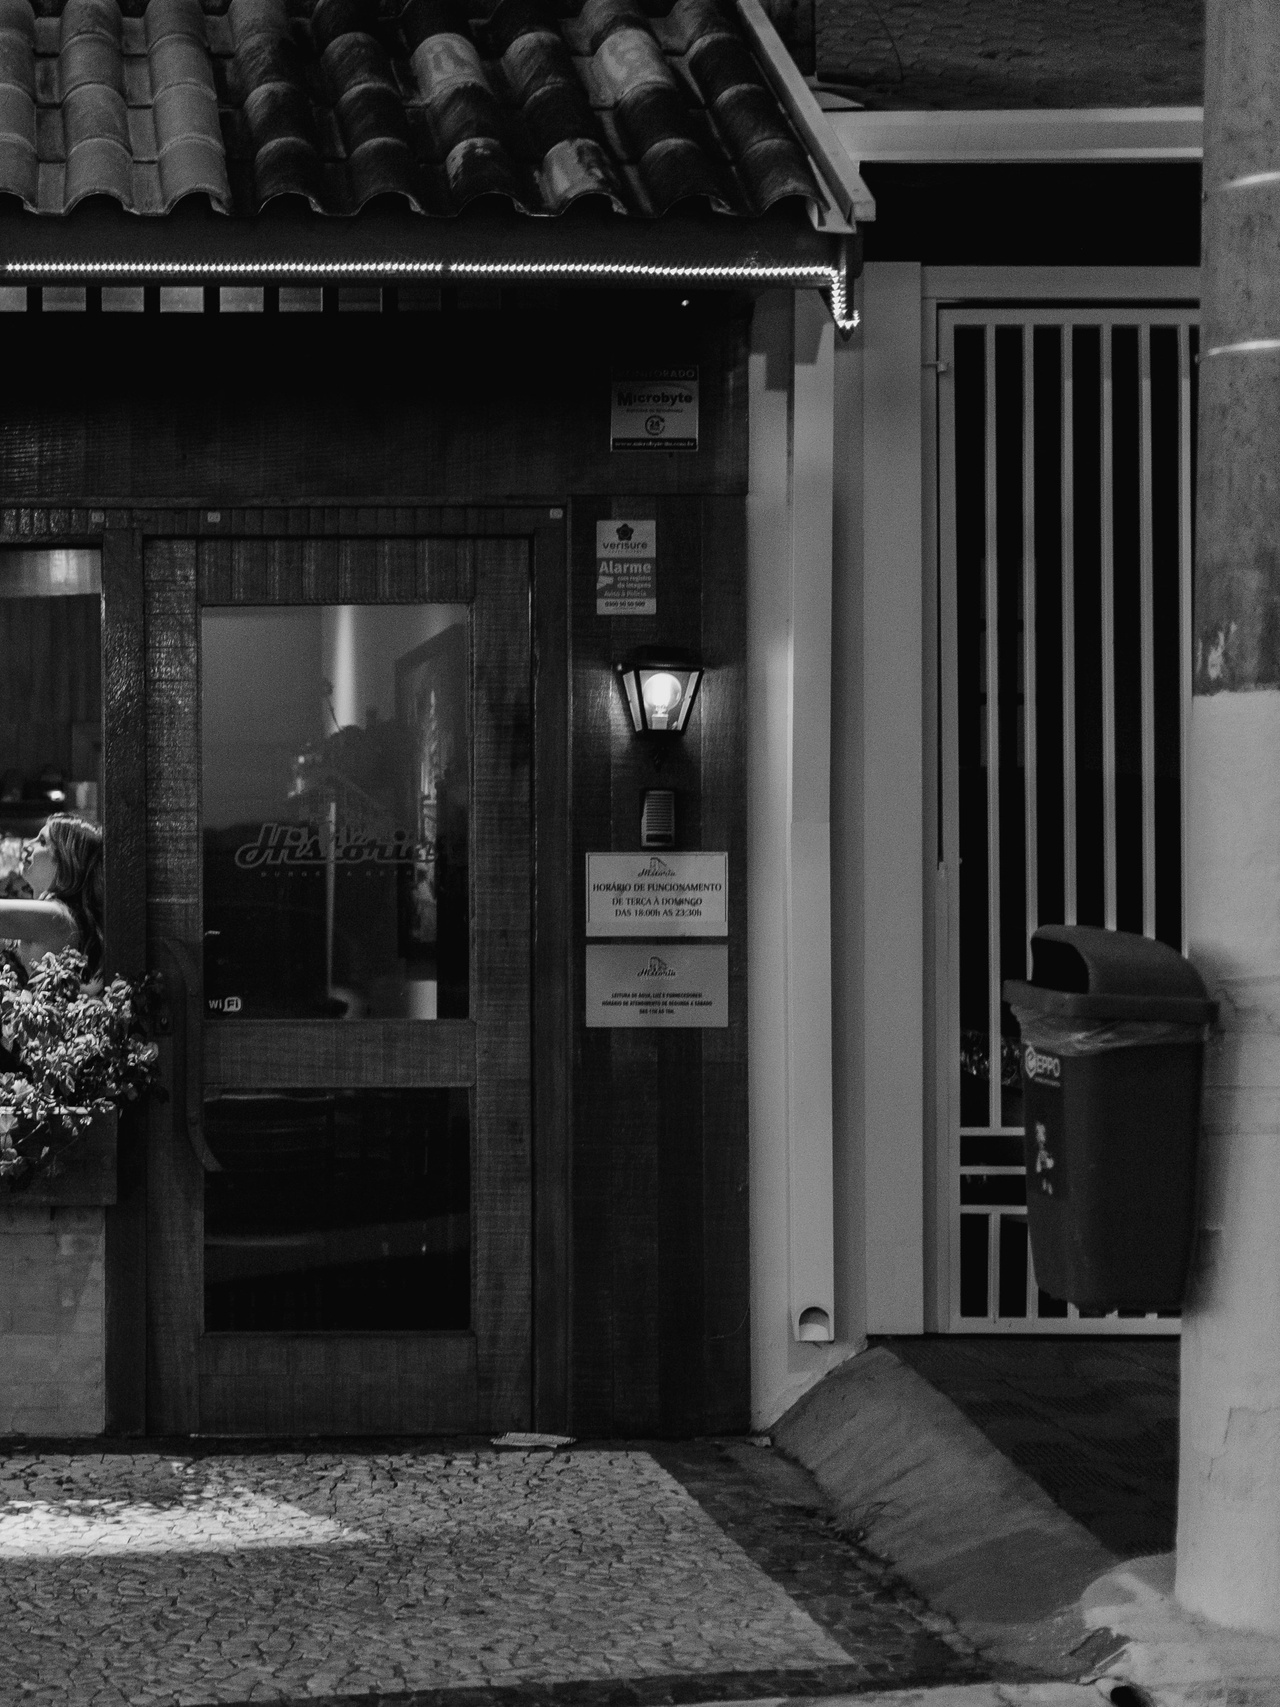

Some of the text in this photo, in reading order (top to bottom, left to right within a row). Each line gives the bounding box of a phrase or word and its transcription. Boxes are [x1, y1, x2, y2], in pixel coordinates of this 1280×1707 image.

[617, 392, 693, 406] Microbyte
[603, 542, 648, 550] verisure
[599, 560, 652, 574] Alarme
[593, 881, 722, 892] HORÁRIO DE FUNCIONAMENTO
[626, 898, 652, 907] TERÇA
[662, 898, 703, 907] DOMINGO
[615, 909, 632, 917] DAS
